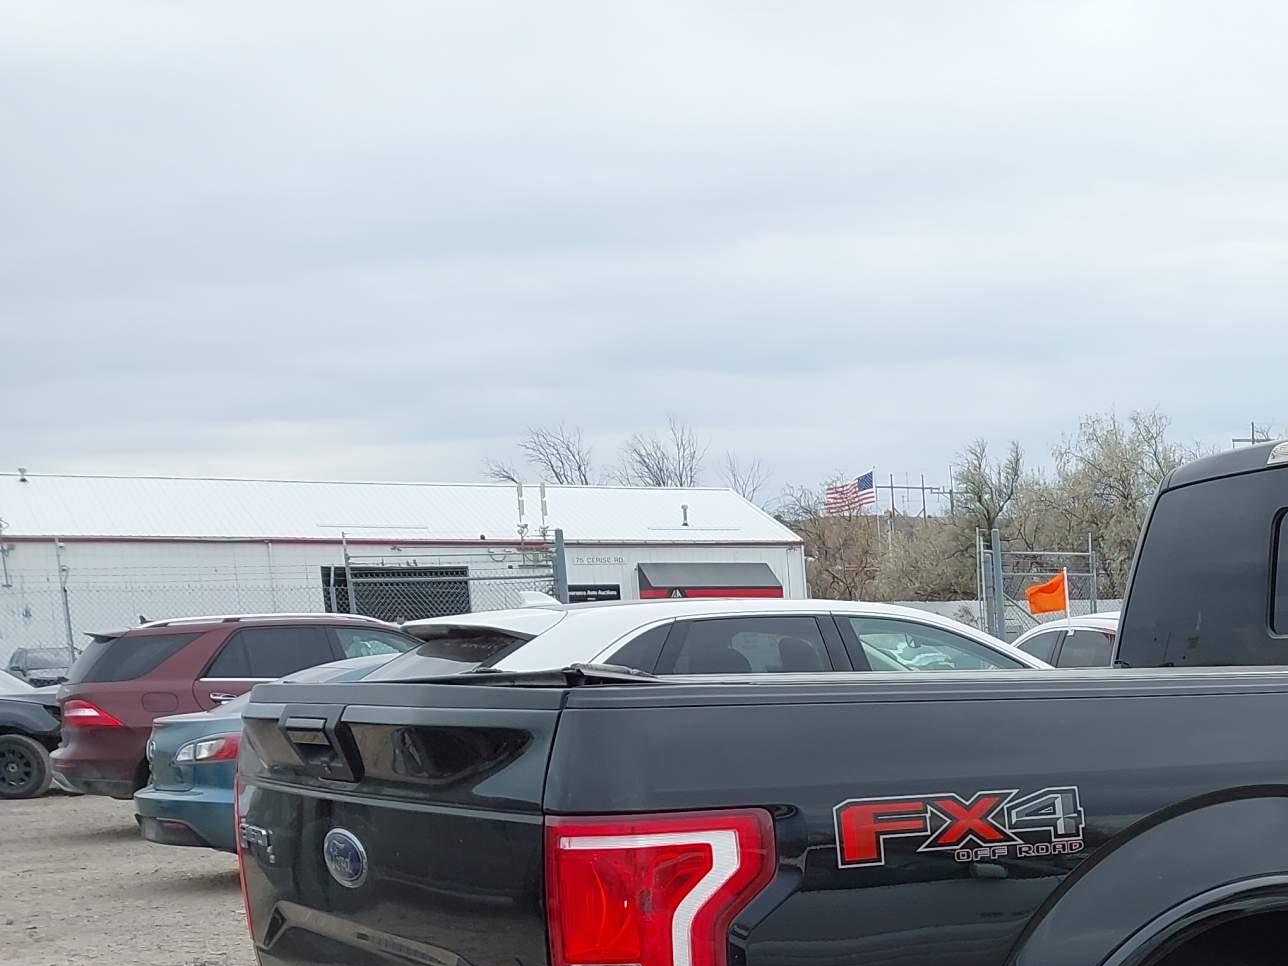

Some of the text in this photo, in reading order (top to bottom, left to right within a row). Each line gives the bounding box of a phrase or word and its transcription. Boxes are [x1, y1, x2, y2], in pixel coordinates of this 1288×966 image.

[833, 786, 1085, 869] FX4
[954, 840, 1084, 862] OFF ROAD
